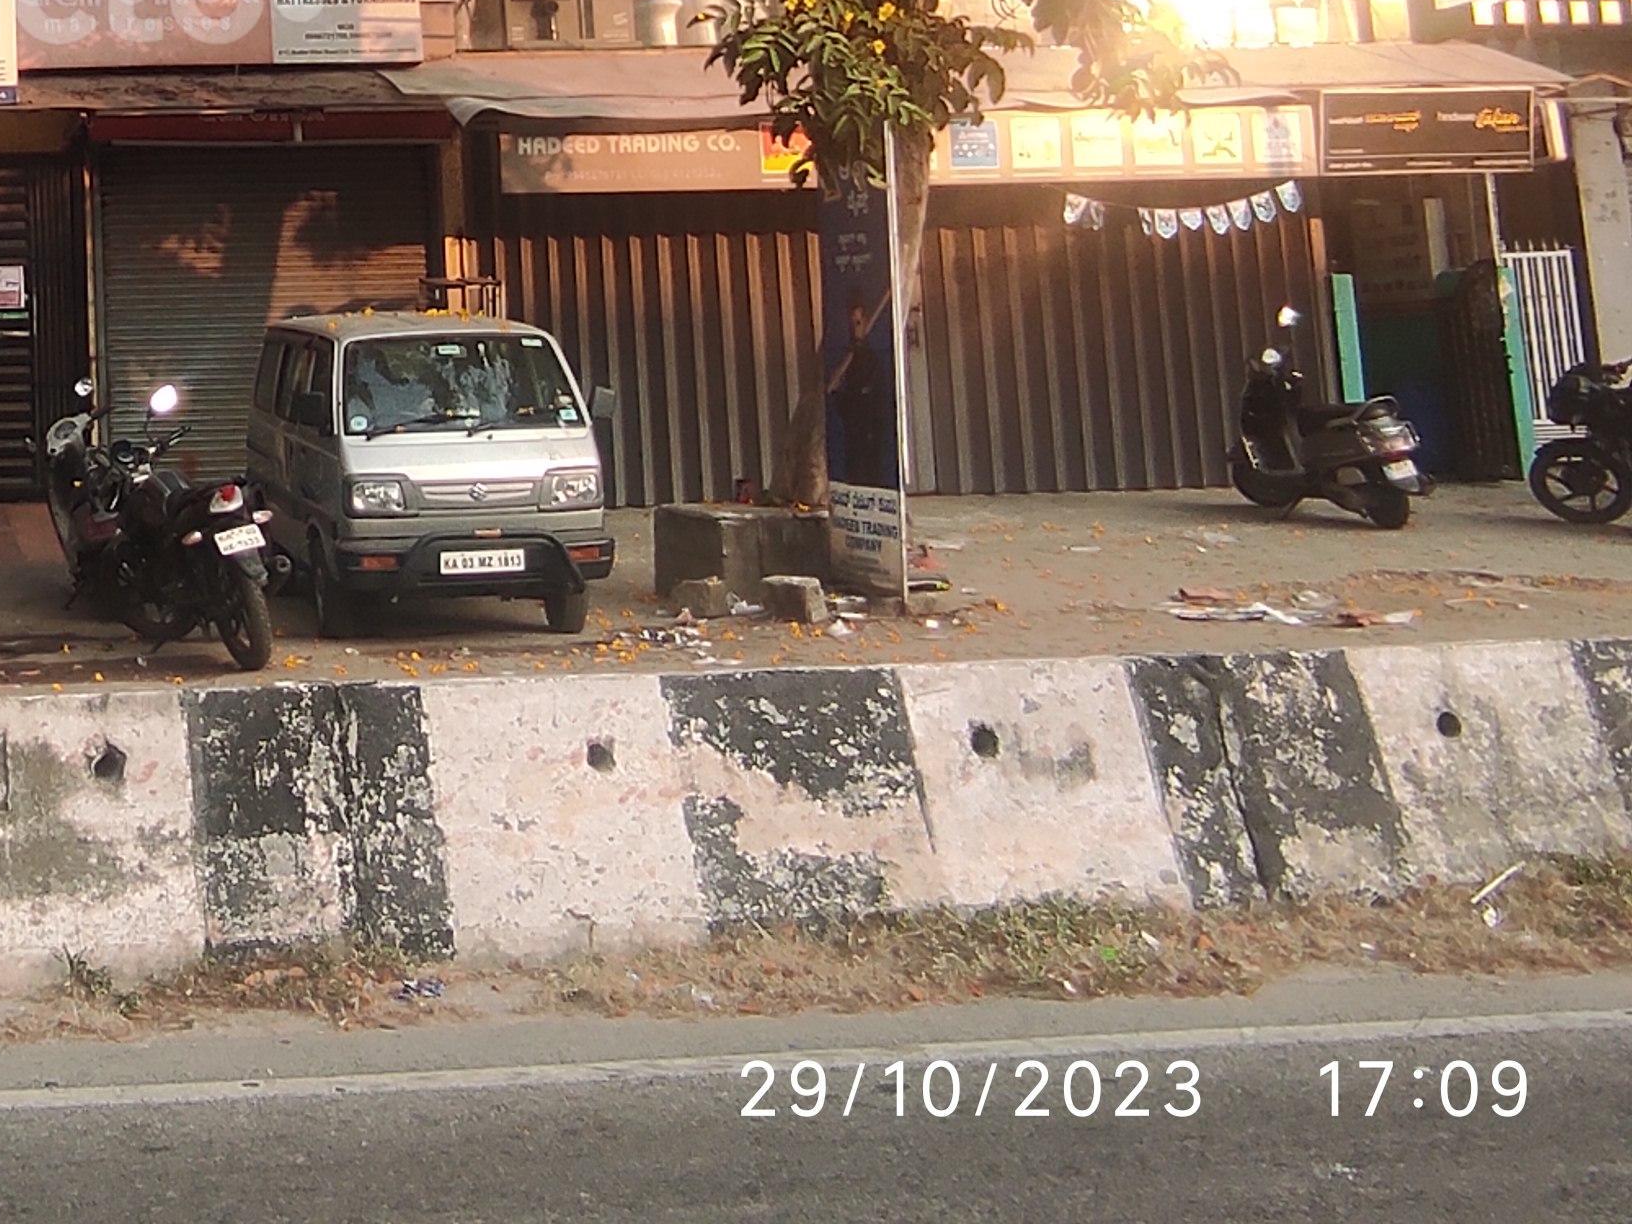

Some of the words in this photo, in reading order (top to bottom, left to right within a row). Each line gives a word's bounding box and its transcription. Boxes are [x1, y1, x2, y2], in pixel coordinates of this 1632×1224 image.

[517, 135, 601, 156] HADEED
[607, 134, 701, 155] TRADING
[707, 133, 742, 152] CO.
[444, 557, 459, 569] KA
[478, 556, 493, 567] MZ
